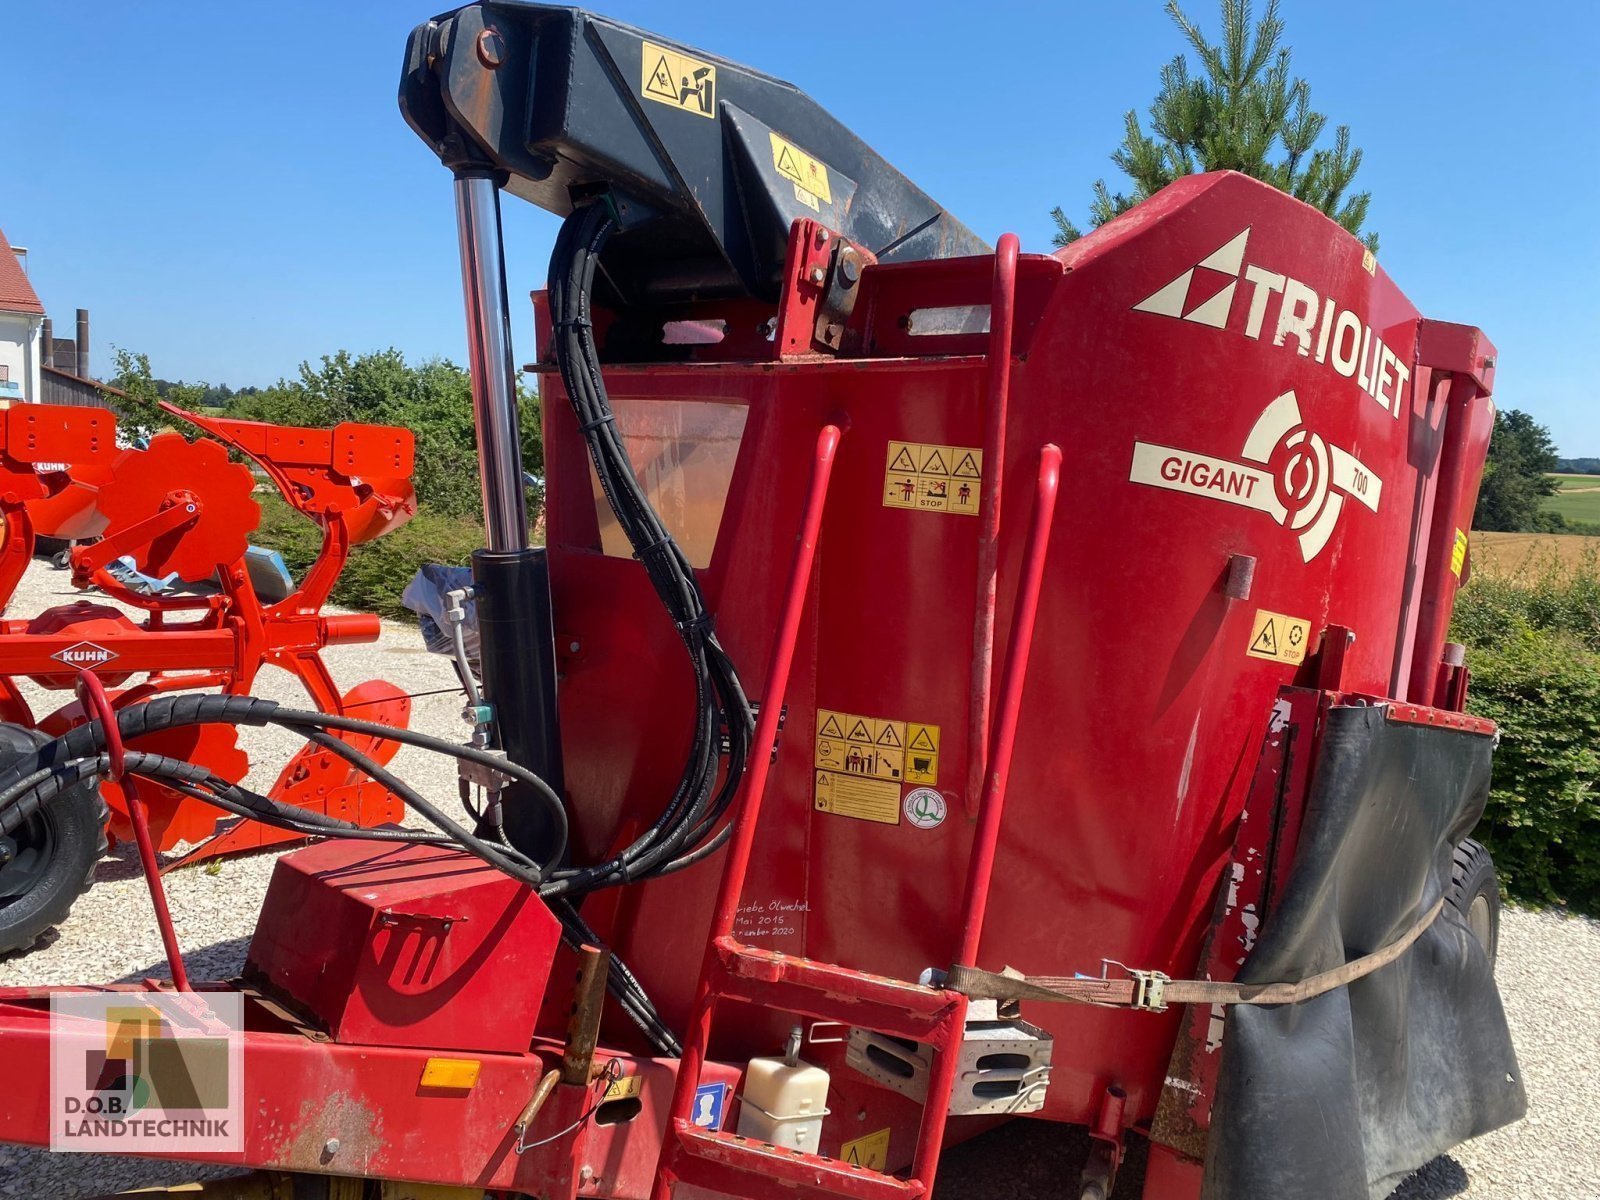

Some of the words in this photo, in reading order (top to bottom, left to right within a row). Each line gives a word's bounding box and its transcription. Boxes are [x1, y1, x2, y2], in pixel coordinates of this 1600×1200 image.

[1243, 262, 1410, 421] TRIOLIET
[37, 462, 66, 471] KUHN
[1159, 456, 1260, 500] GIGANT
[1353, 467, 1369, 496] 700
[920, 499, 943, 507] STOP
[62, 651, 108, 661] KUHN
[1283, 649, 1300, 659] STOP
[758, 915, 785, 925] 2015
[771, 927, 795, 936] 2020
